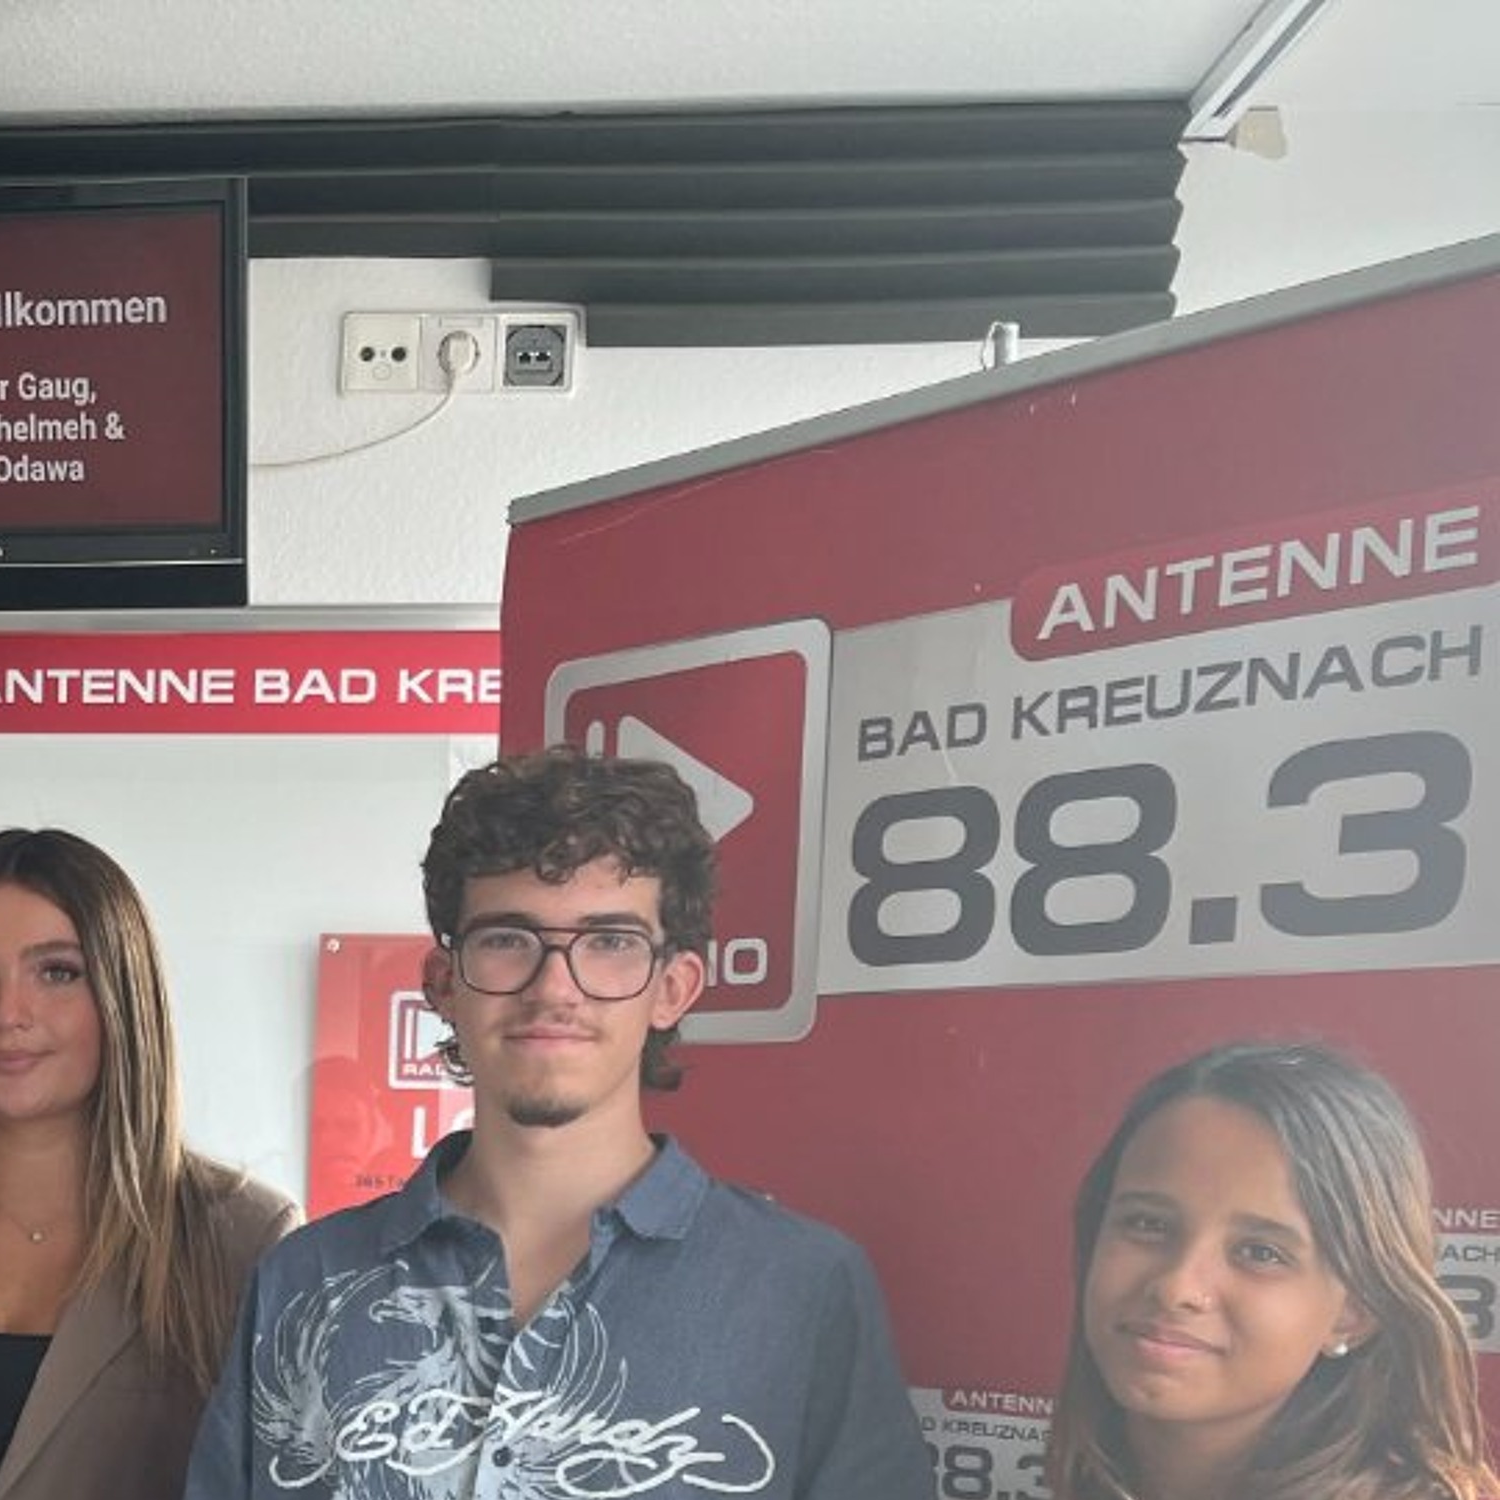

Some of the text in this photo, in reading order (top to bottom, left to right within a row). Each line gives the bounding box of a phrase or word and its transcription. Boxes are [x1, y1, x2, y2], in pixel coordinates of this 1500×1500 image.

[17, 373, 97, 405] Gaug,
[104, 412, 125, 440] &
[1037, 505, 1480, 640] ANTENNE
[253, 669, 376, 704] BAD
[857, 624, 1483, 762] BAD KREUZNACH
[847, 730, 1473, 967] 88.3
[951, 1389, 1054, 1414] ANTENN
